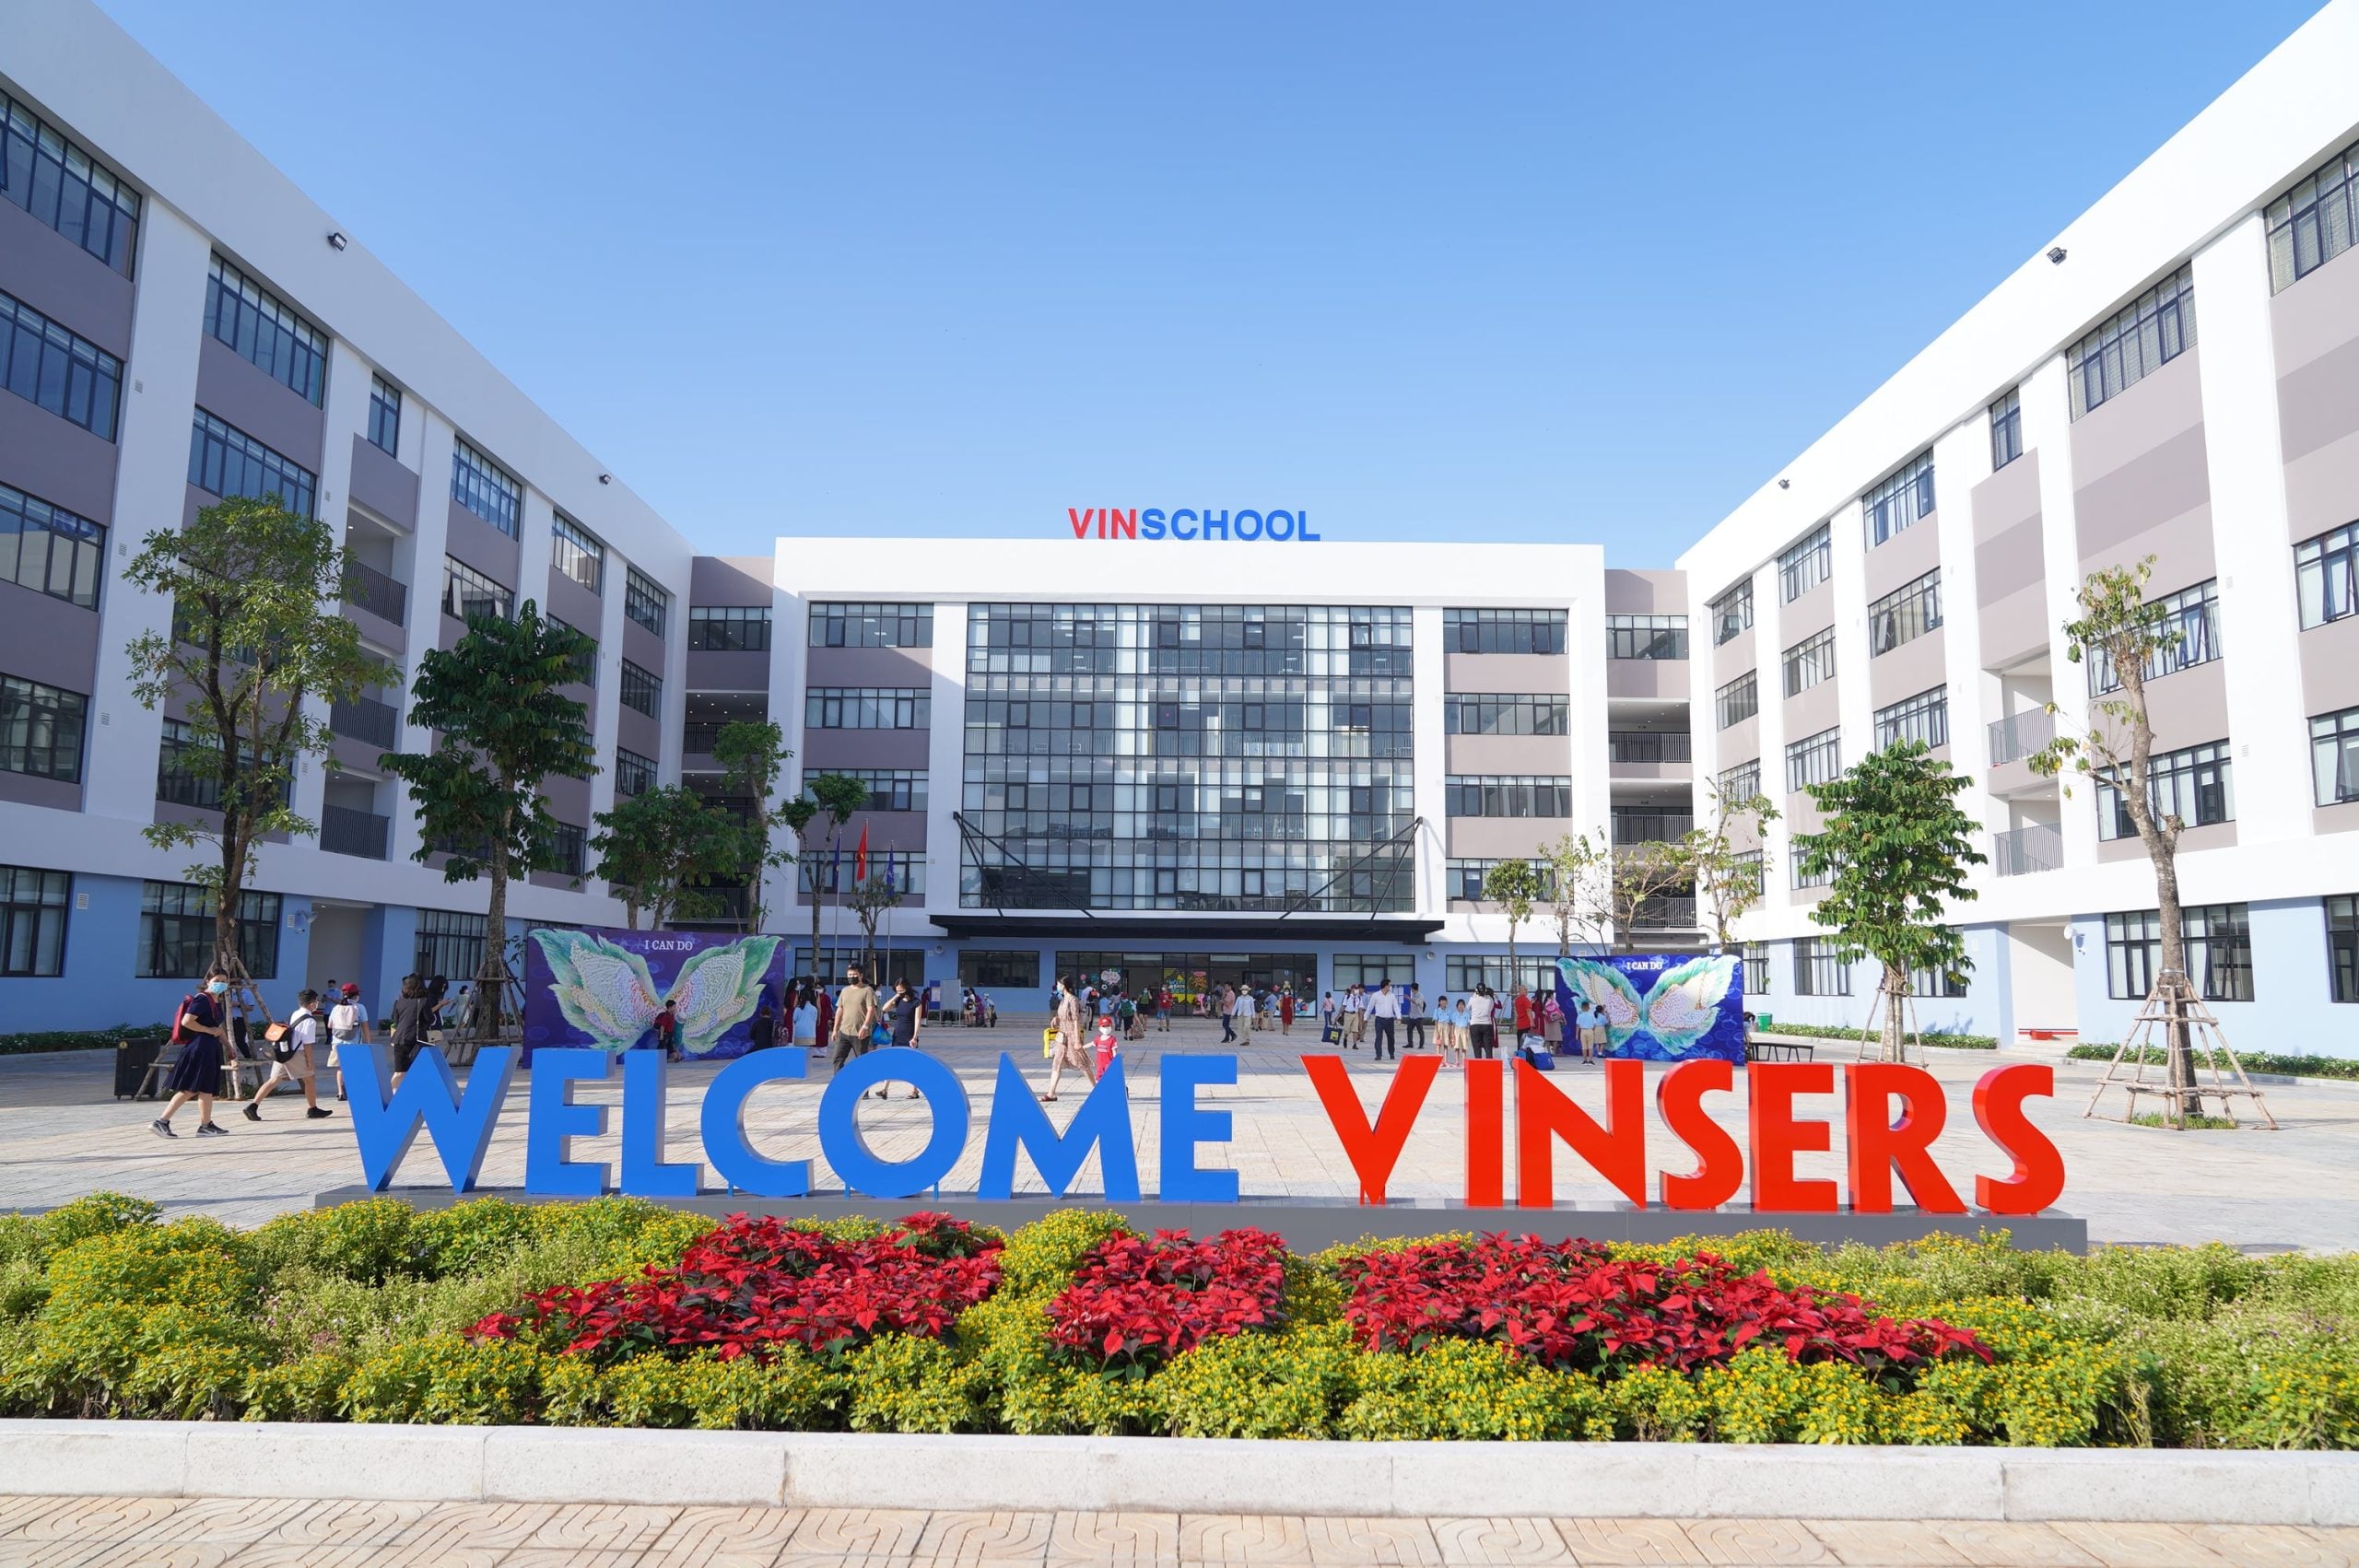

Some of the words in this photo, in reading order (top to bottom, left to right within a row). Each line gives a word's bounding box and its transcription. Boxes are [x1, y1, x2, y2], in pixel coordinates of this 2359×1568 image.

[1068, 508, 1320, 542] VINSCHOOL
[645, 940, 650, 950] I
[651, 940, 675, 951] CAN
[676, 941, 693, 952] DO
[1631, 961, 1649, 971] CAN
[1649, 962, 1662, 971] DO
[337, 1043, 1240, 1202] WELCOME
[1300, 1054, 2066, 1214] VINSERS
